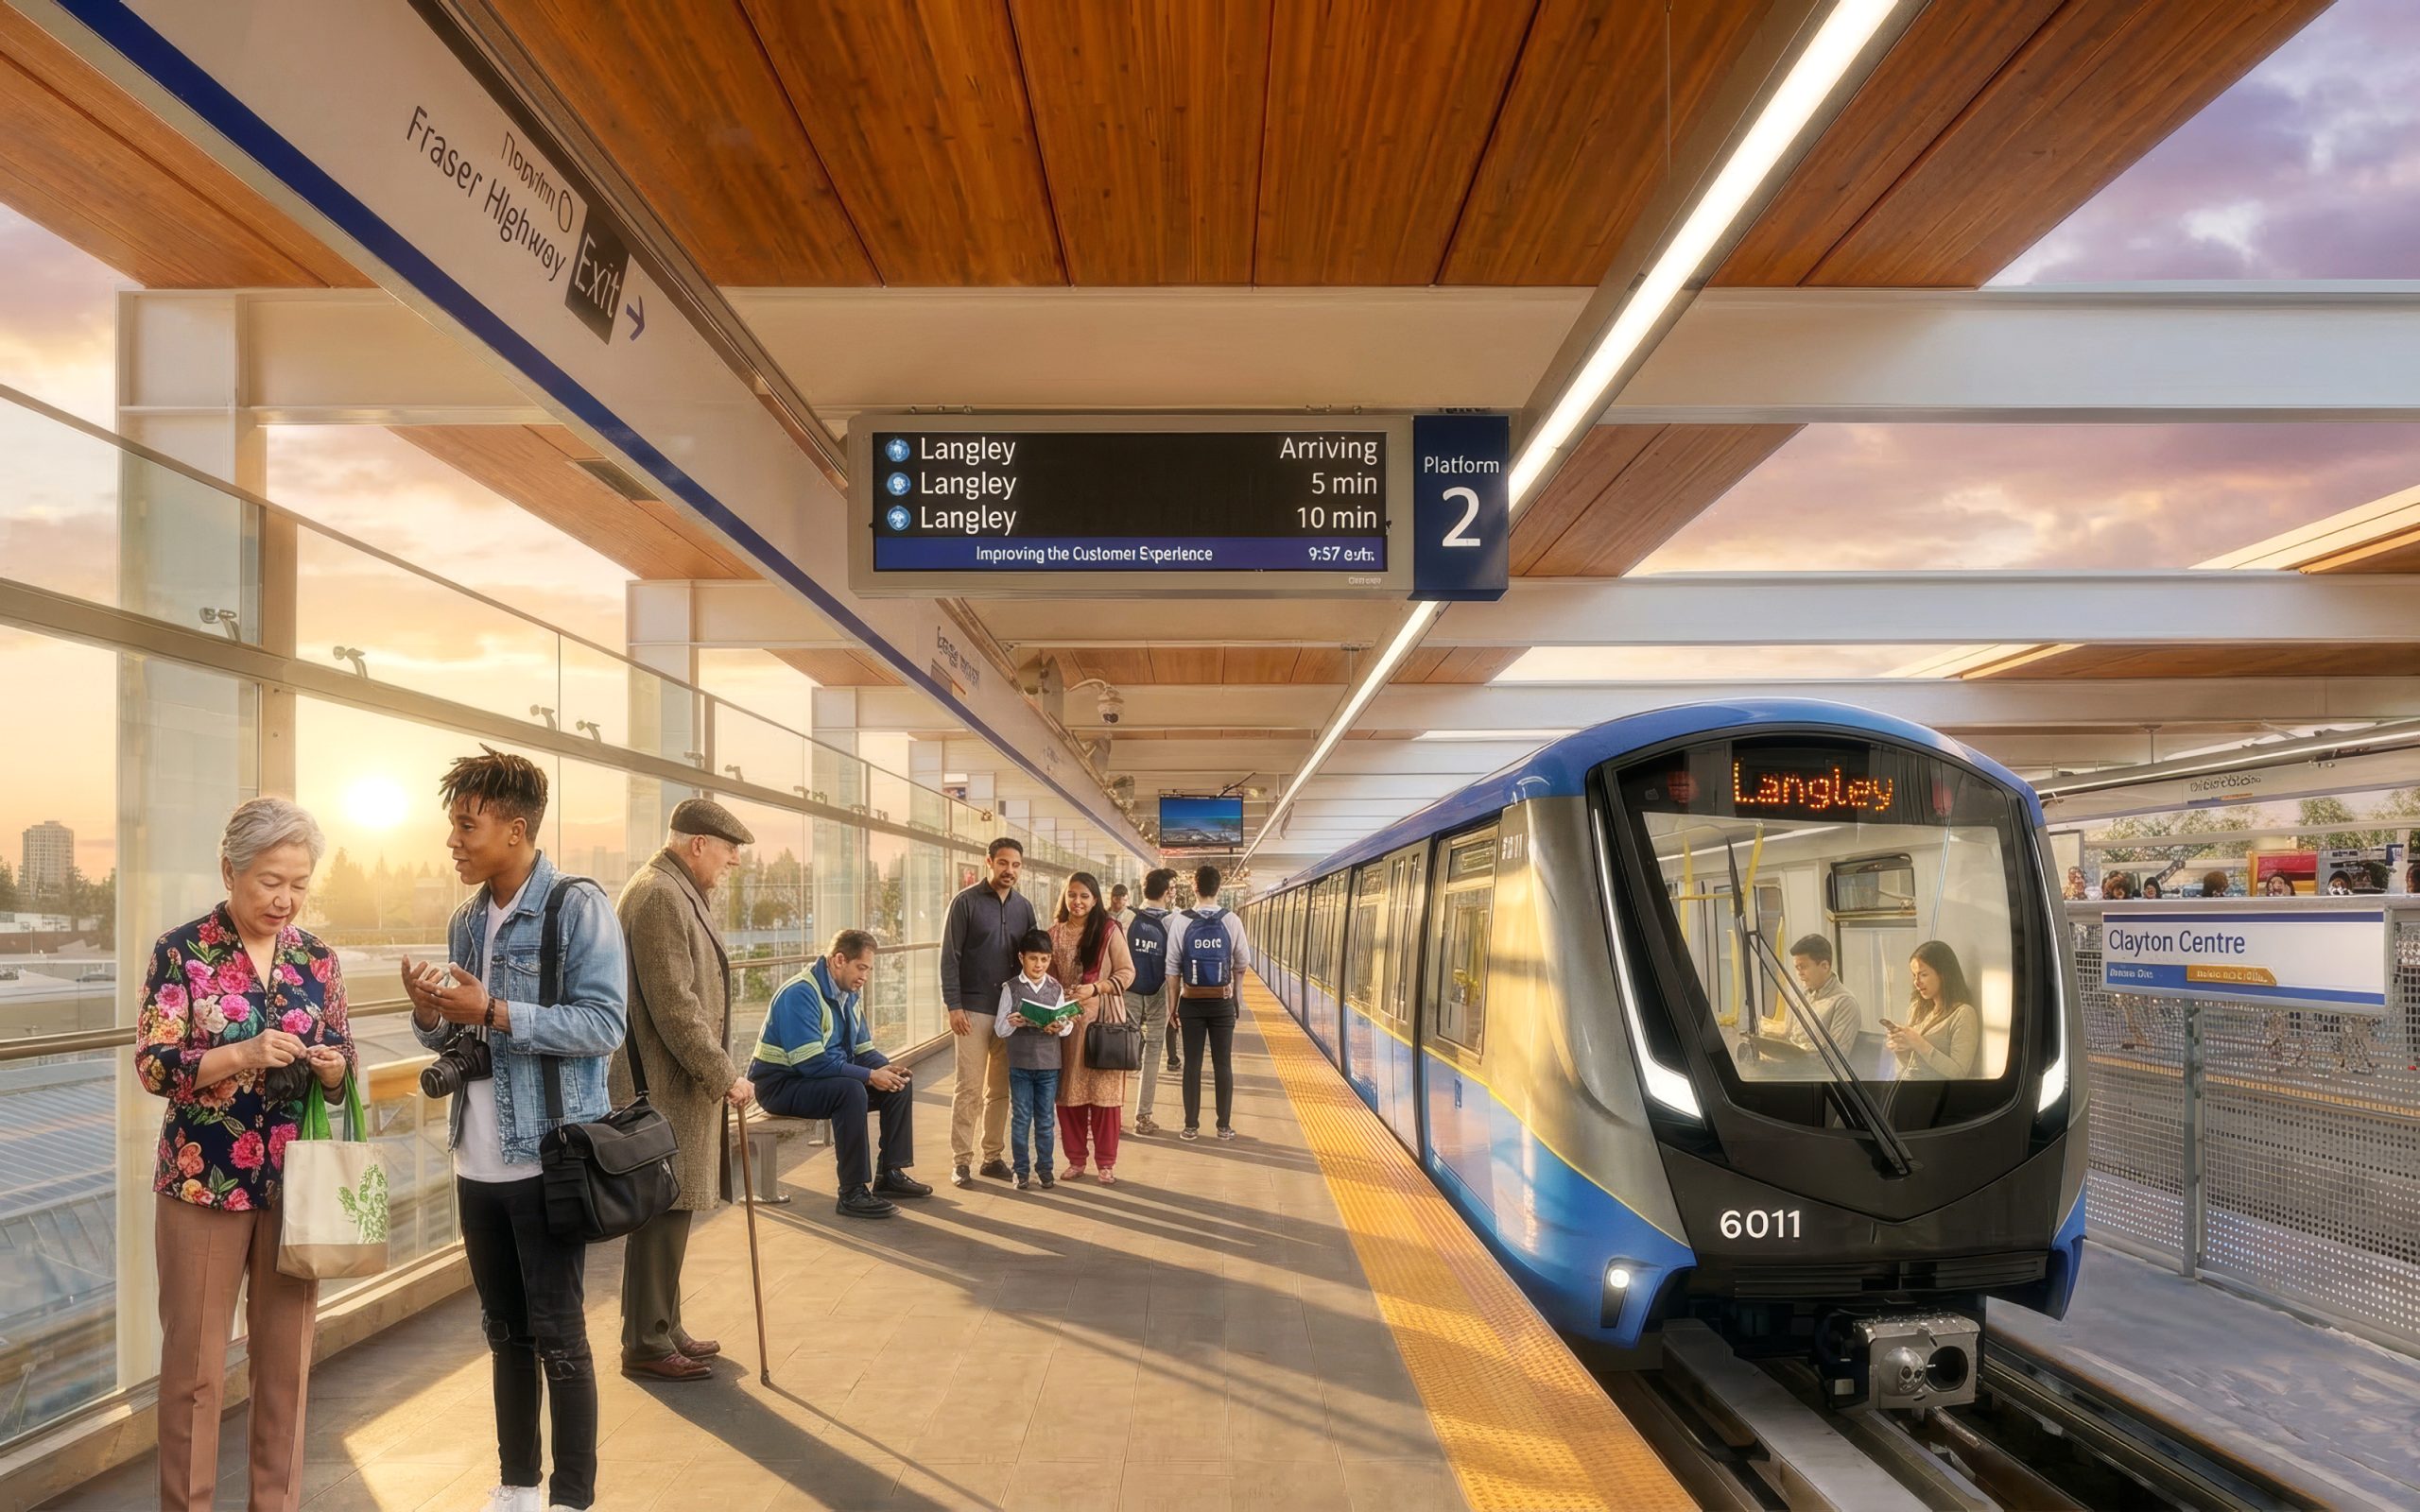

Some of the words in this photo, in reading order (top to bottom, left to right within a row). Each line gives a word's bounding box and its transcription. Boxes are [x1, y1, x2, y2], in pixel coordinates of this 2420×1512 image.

[406, 105, 483, 198] Fraser
[574, 232, 621, 318] Exit
[920, 436, 1016, 466] Langley
[1279, 436, 1377, 466] Arriving
[1424, 455, 1500, 473] Platform
[920, 470, 1017, 501] Langley
[1311, 472, 1325, 495] 5
[1333, 472, 1377, 495] min
[920, 504, 1017, 536] Langley
[1296, 506, 1325, 529] 10
[1332, 505, 1377, 529] min
[1442, 487, 1481, 547] 2
[976, 545, 1045, 564] Improving
[1046, 545, 1070, 561] the
[1072, 546, 1136, 561] Customer
[1139, 545, 1213, 564] Experience
[1308, 545, 1341, 561] 9:57
[1732, 760, 1893, 812] Langley
[2108, 929, 2173, 958] Clayton
[2179, 930, 2245, 954] Centre
[1719, 1209, 1801, 1239] 6011
